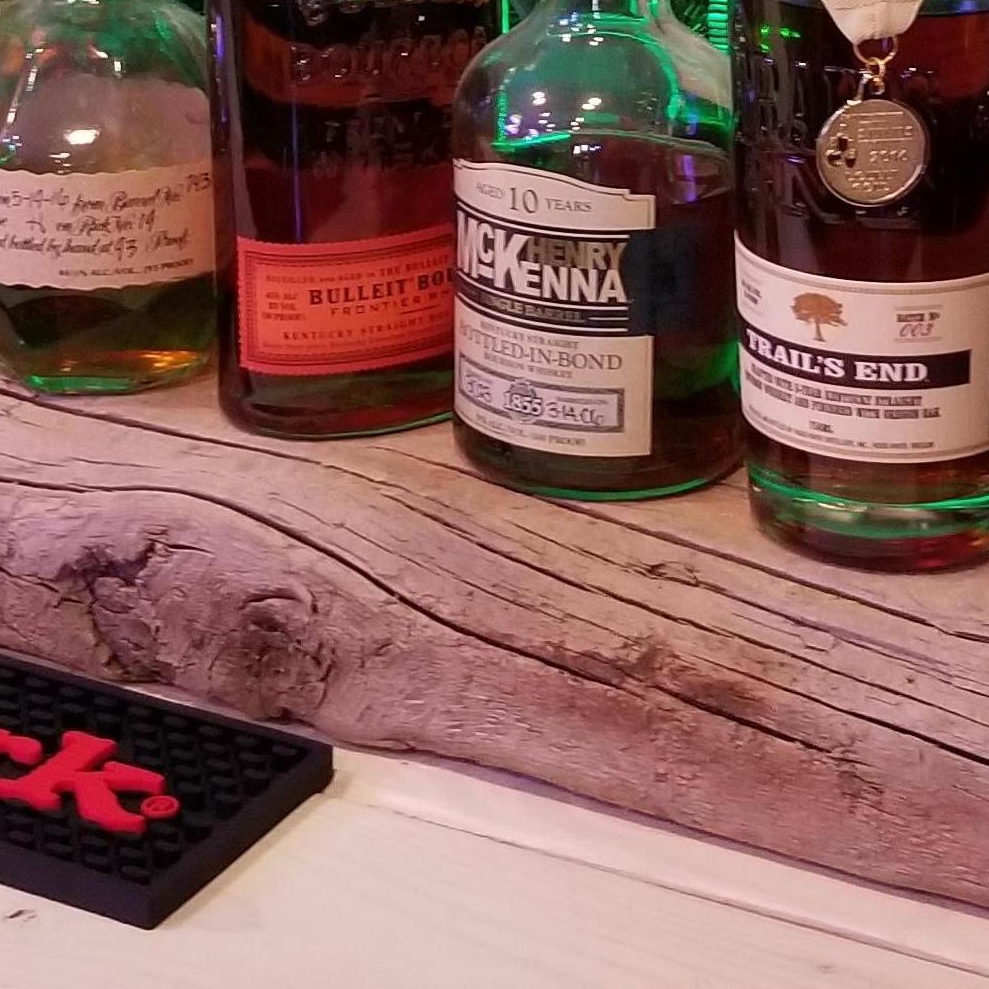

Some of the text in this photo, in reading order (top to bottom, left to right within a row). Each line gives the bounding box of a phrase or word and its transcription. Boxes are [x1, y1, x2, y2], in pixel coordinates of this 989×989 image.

[509, 186, 539, 214] 10
[545, 197, 592, 213] YEARS
[527, 237, 627, 270] HENRY
[308, 279, 408, 306] BULLEIT
[746, 328, 929, 383] TRAIL'S END
